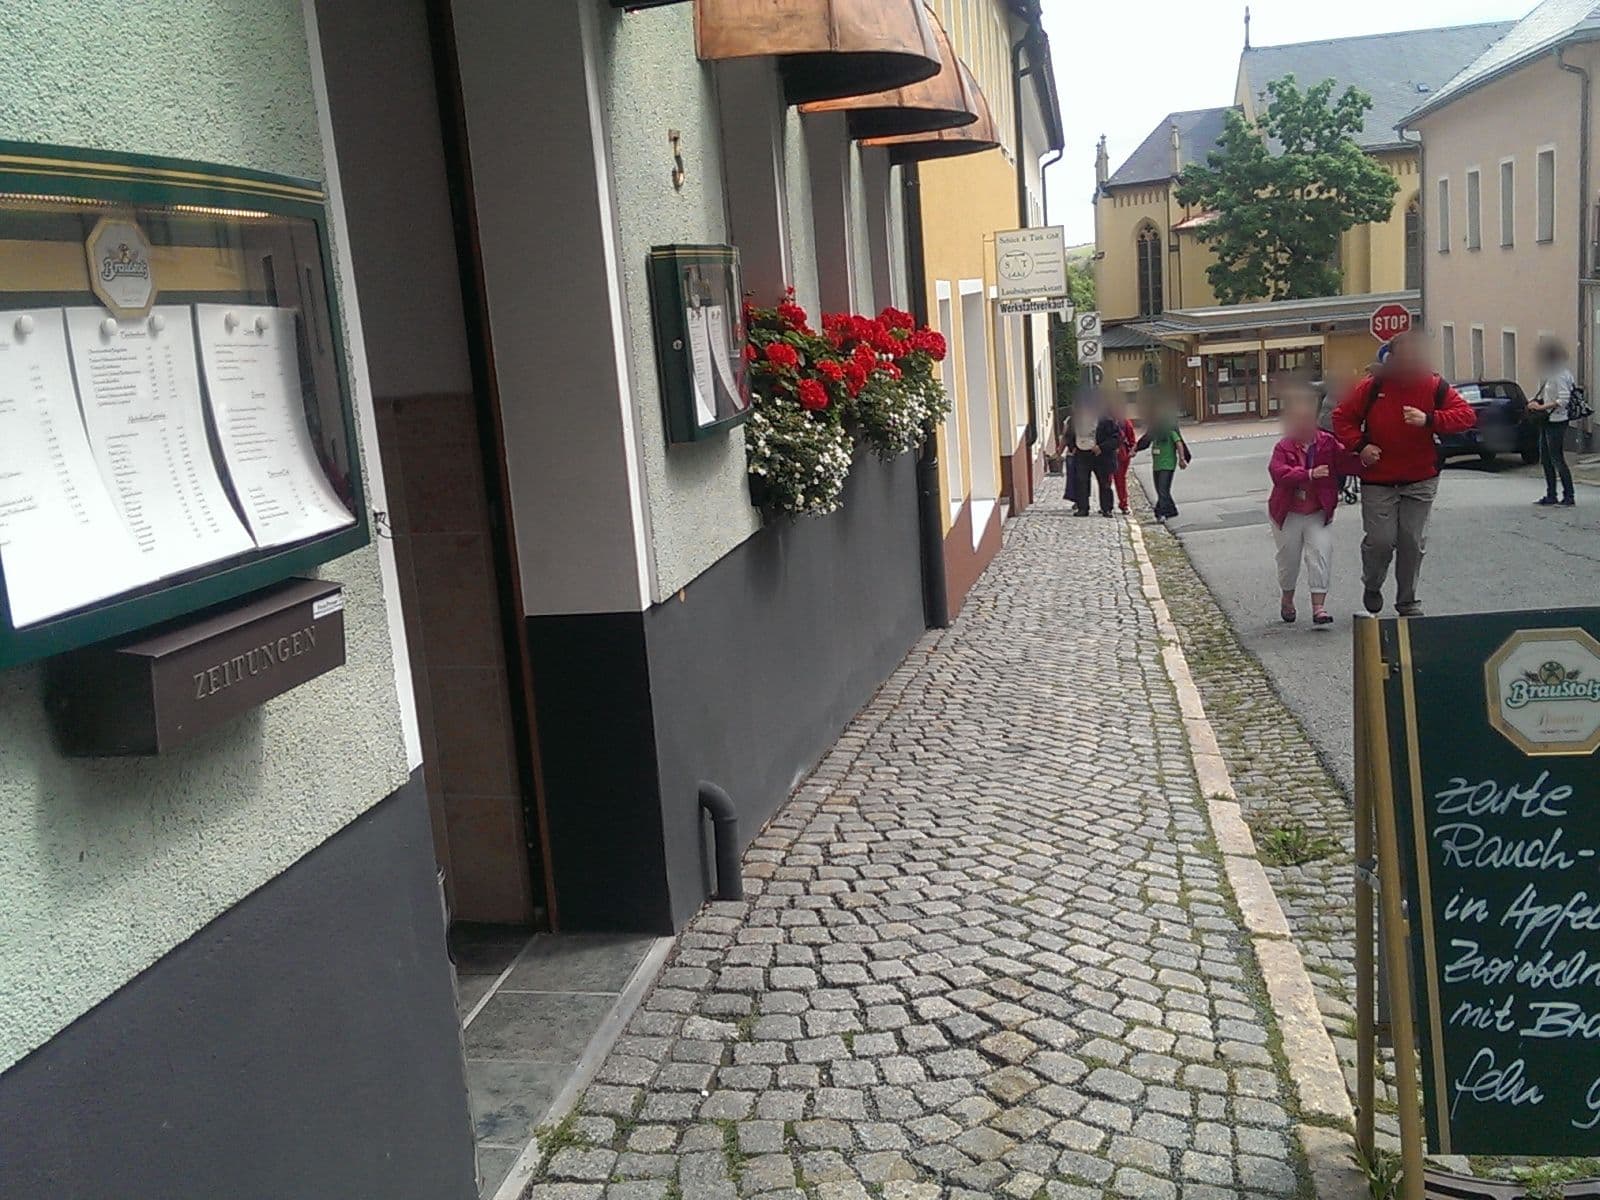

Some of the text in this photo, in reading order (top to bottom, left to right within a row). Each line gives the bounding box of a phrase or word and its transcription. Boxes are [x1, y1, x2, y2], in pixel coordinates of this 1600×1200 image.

[1000, 300, 1065, 313] Werkstattverkauf
[1374, 314, 1407, 331] STOP
[193, 625, 317, 700] ZEITUNGEN
[1433, 822, 1595, 870] Rauch-
[1444, 886, 1490, 923] in
[1450, 994, 1515, 1032] mit
